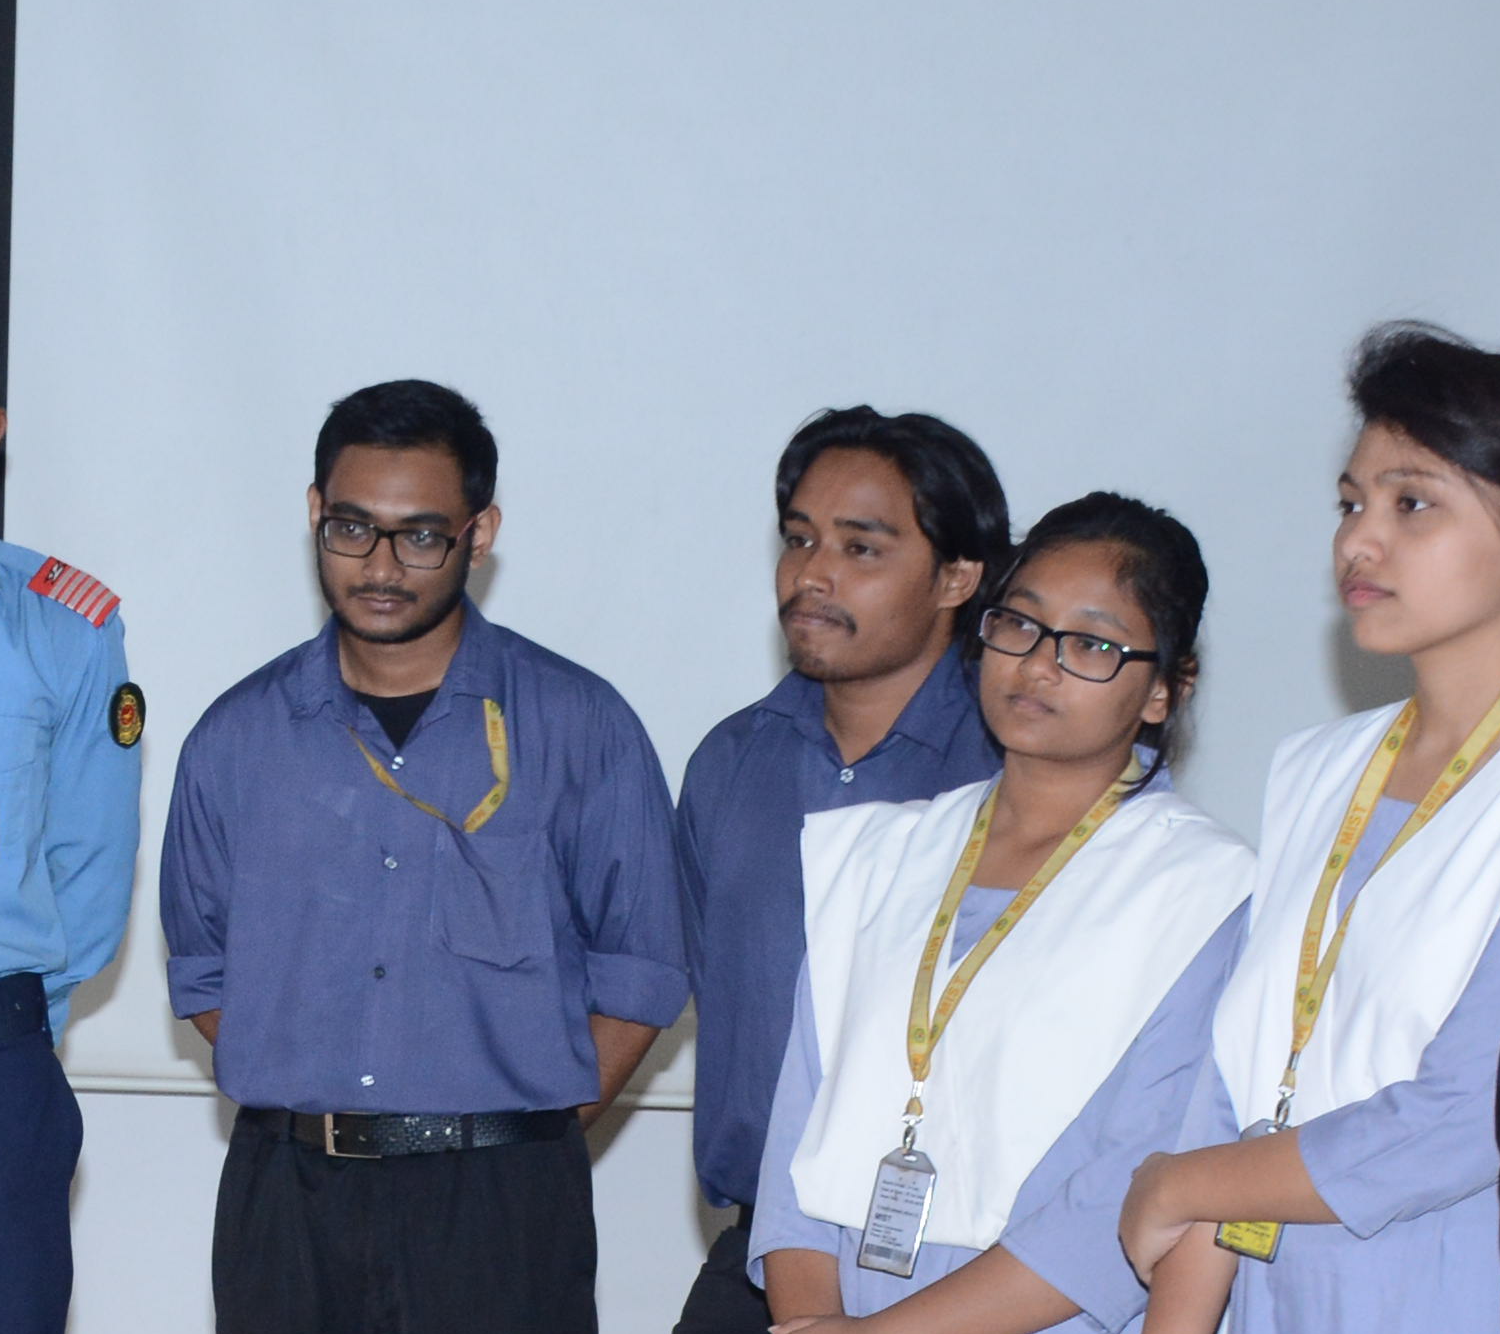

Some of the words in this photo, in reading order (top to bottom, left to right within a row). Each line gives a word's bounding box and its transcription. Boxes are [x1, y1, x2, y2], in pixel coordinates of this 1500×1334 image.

[1415, 781, 1449, 822] MIST
[1340, 803, 1368, 845] MIST
[1303, 929, 1320, 975] MIST
[938, 975, 966, 1016] MIST
